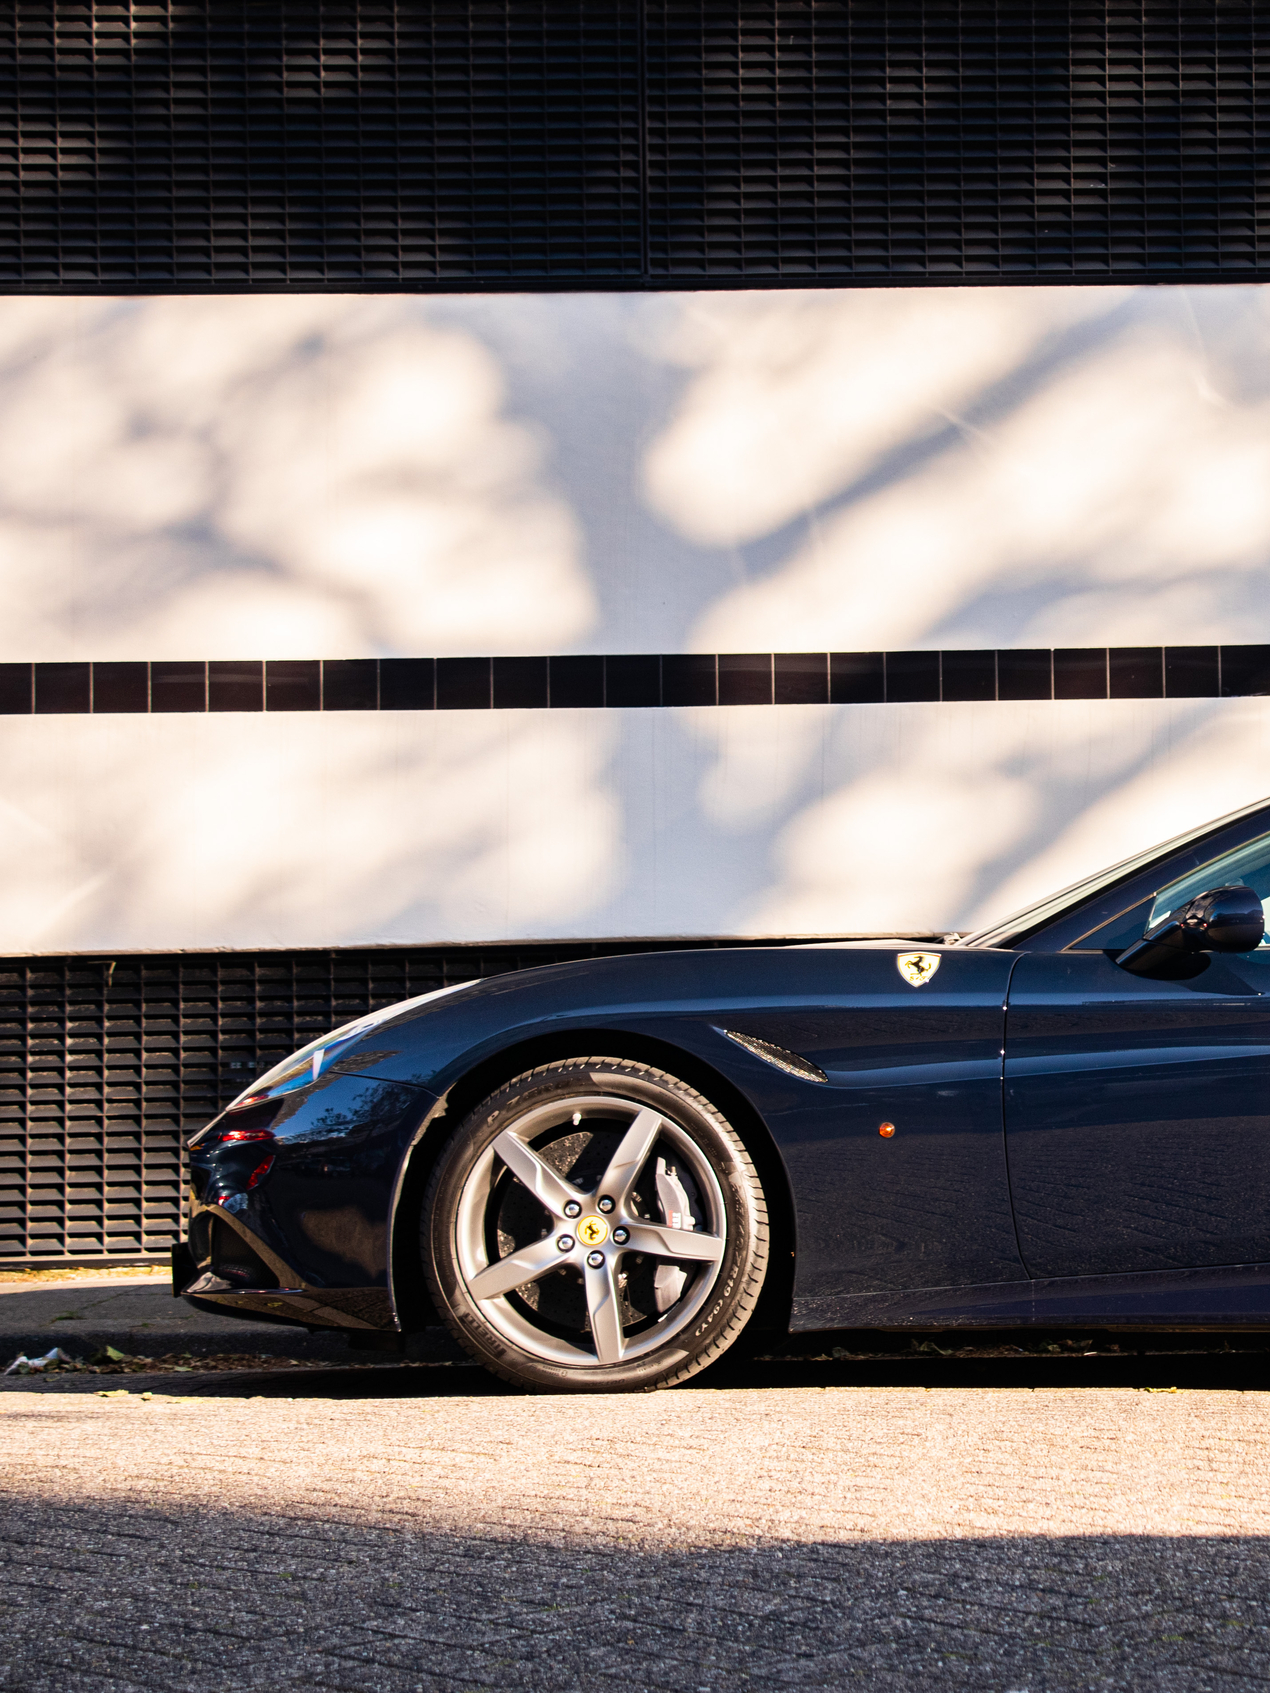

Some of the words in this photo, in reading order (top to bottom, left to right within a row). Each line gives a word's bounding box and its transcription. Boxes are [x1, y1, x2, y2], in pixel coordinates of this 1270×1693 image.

[486, 1110, 498, 1128] P
[459, 1312, 507, 1358] PIRELLI
[694, 1298, 724, 1338] (94Y)
